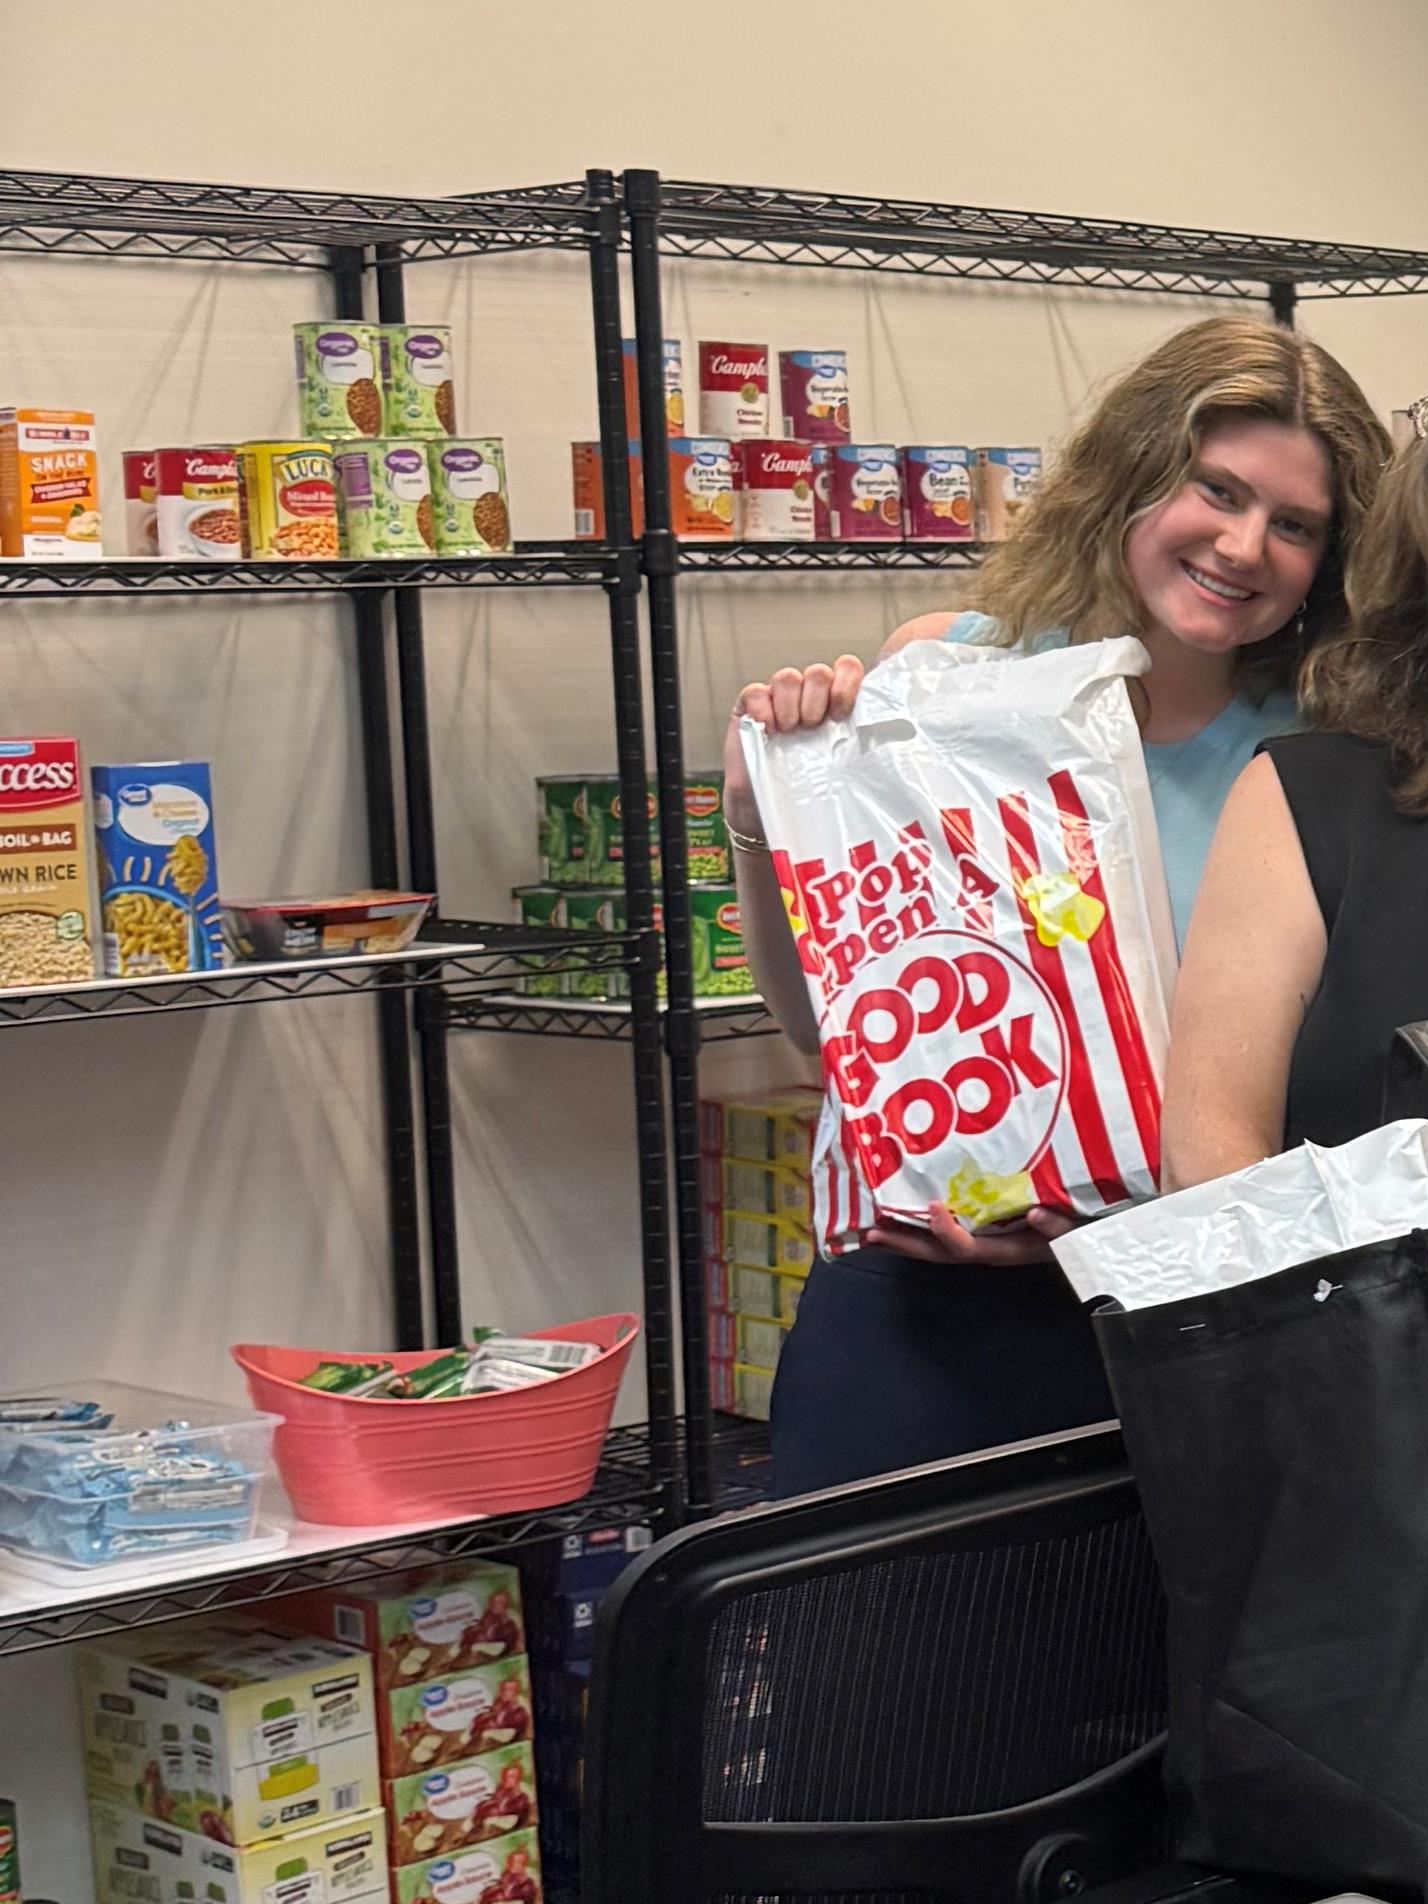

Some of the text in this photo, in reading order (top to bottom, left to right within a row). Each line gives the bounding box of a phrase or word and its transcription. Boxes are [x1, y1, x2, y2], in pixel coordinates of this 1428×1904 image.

[31, 453, 88, 474] SNACK
[42, 831, 72, 847] BAG
[35, 863, 77, 882] RICE
[823, 952, 1010, 1108] GOOD
[841, 1013, 1058, 1188] BOOK
